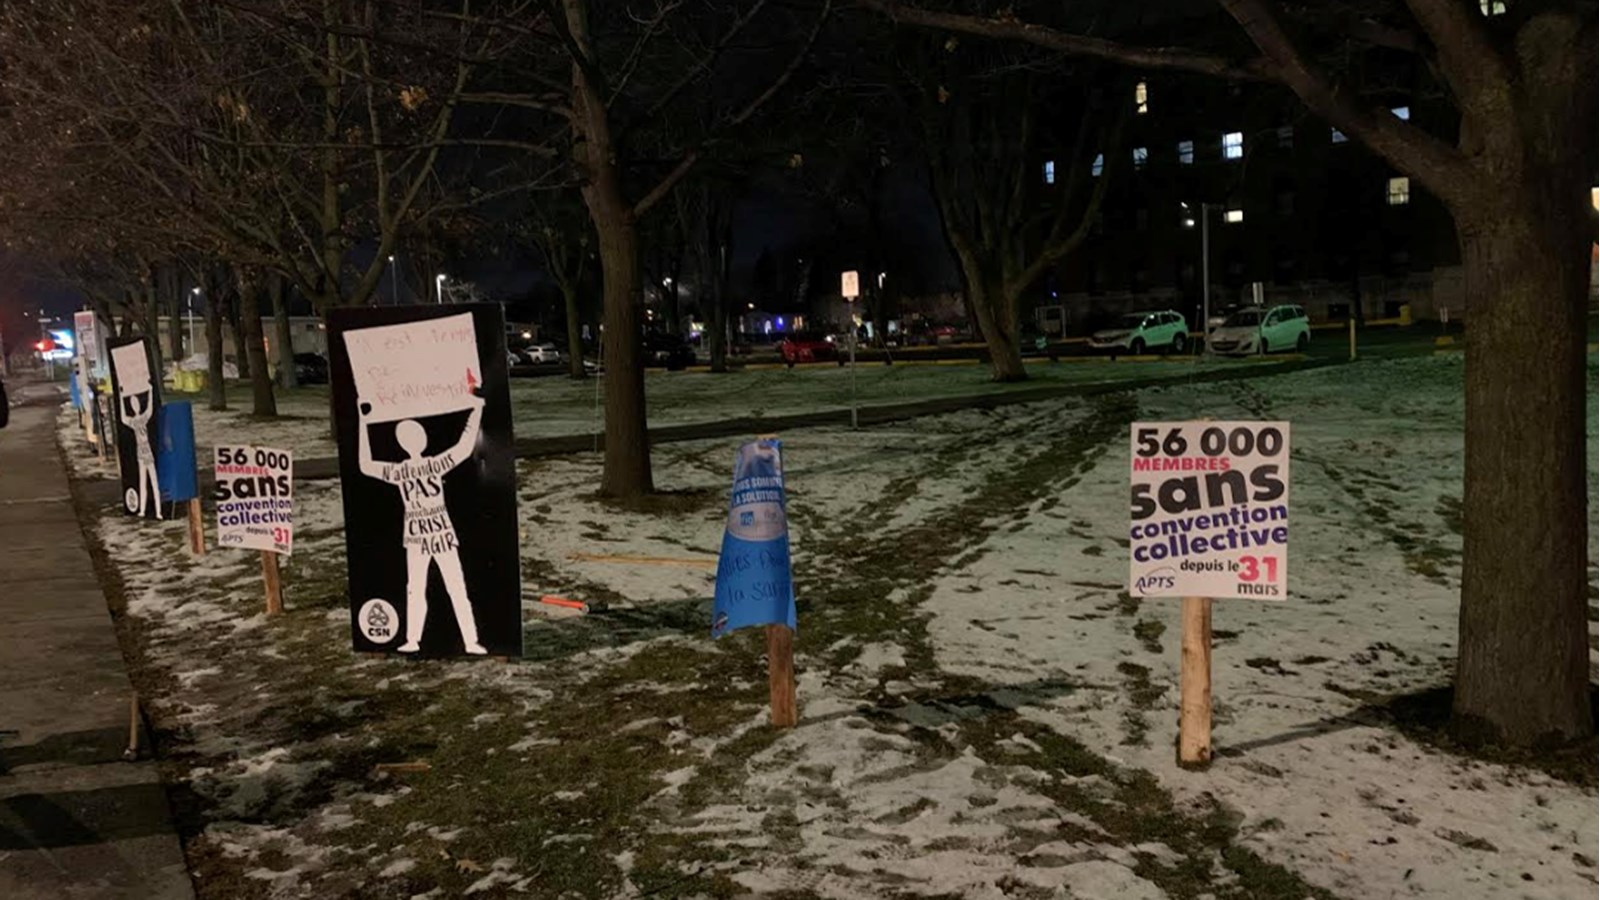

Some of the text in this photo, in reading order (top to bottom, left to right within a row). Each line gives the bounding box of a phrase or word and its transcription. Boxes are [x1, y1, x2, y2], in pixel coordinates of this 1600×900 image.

[1136, 426, 1283, 458] 56 000
[217, 448, 289, 471] 56 000
[1133, 457, 1231, 471] MEMBRES
[215, 475, 290, 501] sans
[403, 475, 441, 501] PAS
[1131, 464, 1285, 520] sans
[217, 498, 292, 513] convention
[219, 510, 293, 526] collective
[1131, 504, 1287, 540] convention
[274, 527, 289, 544] 31
[421, 531, 460, 555] AGIR
[1134, 525, 1288, 563] collective
[1180, 555, 1278, 582] depuis le 31
[1135, 576, 1175, 589] APTS
[1237, 583, 1279, 596] mars
[368, 628, 390, 637] CSN
